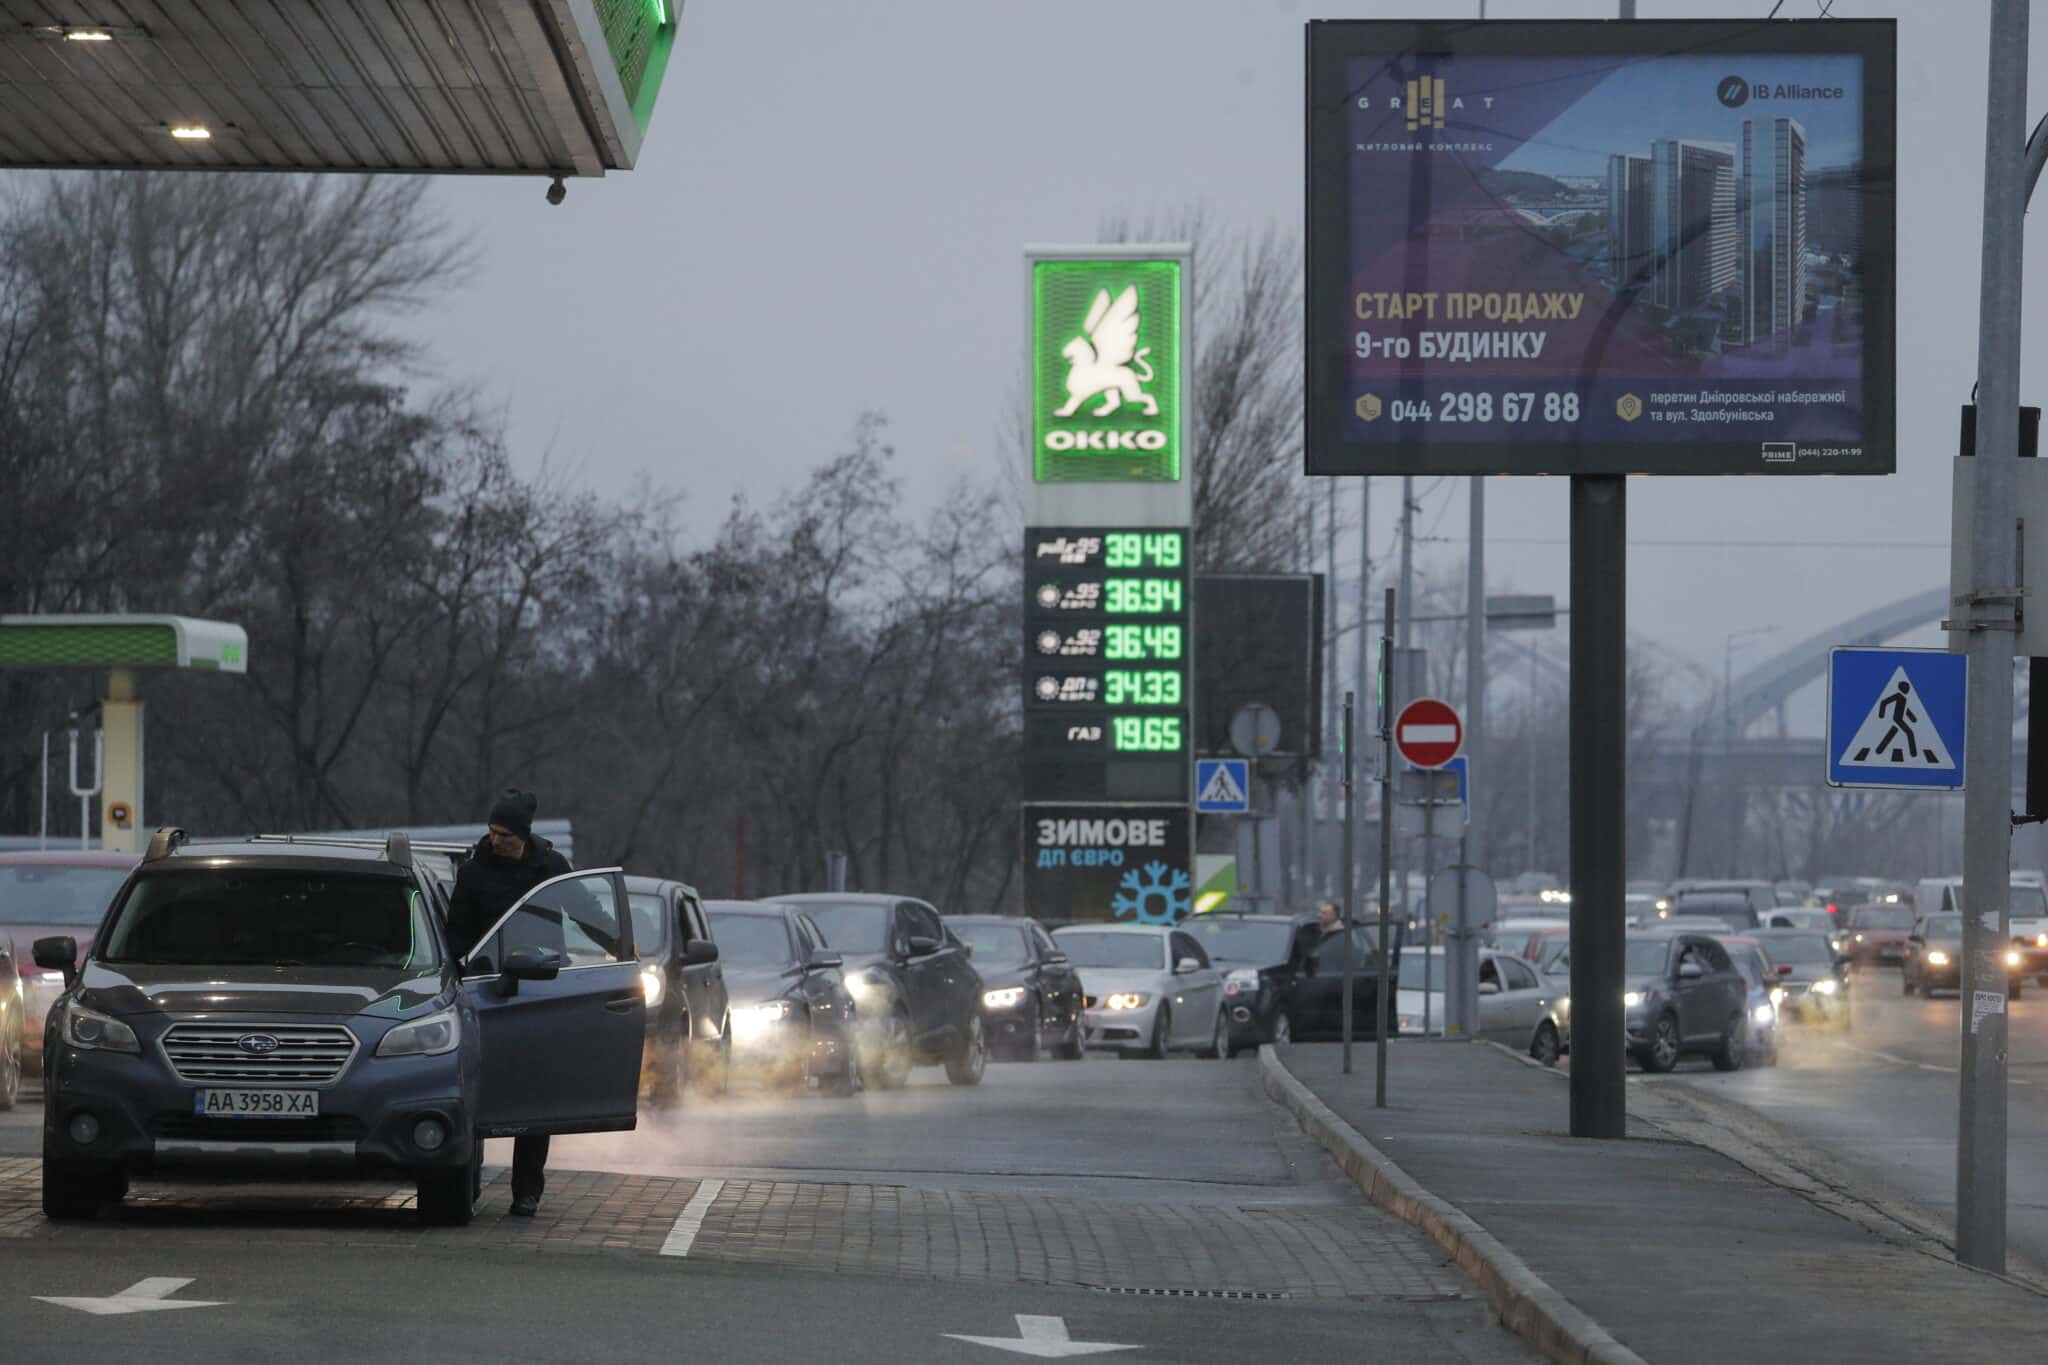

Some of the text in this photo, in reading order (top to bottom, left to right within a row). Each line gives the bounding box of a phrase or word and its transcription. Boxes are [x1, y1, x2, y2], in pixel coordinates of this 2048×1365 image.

[1752, 83, 1844, 99] IB Alliance
[1428, 143, 1493, 151] КОМПЛЕКС
[1355, 292, 1585, 323] СТАРТ ПРОДАЖУ
[1355, 331, 1547, 362] 9-го БУДИНКУ
[1391, 392, 1581, 422] 044 298 67 88
[1650, 390, 1846, 406] перетин Дніпровської набережної
[1650, 411, 1663, 421] та
[1690, 408, 1775, 424] Здолбунівська
[1044, 429, 1168, 451] OKKO
[1105, 625, 1181, 659] 36.49
[1037, 819, 1166, 846] ЗИМОВЕ
[1037, 850, 1124, 868] ДП ЄВРО
[207, 1092, 235, 1111] AA
[239, 1093, 284, 1112] 3958
[287, 1094, 315, 1112] XA
